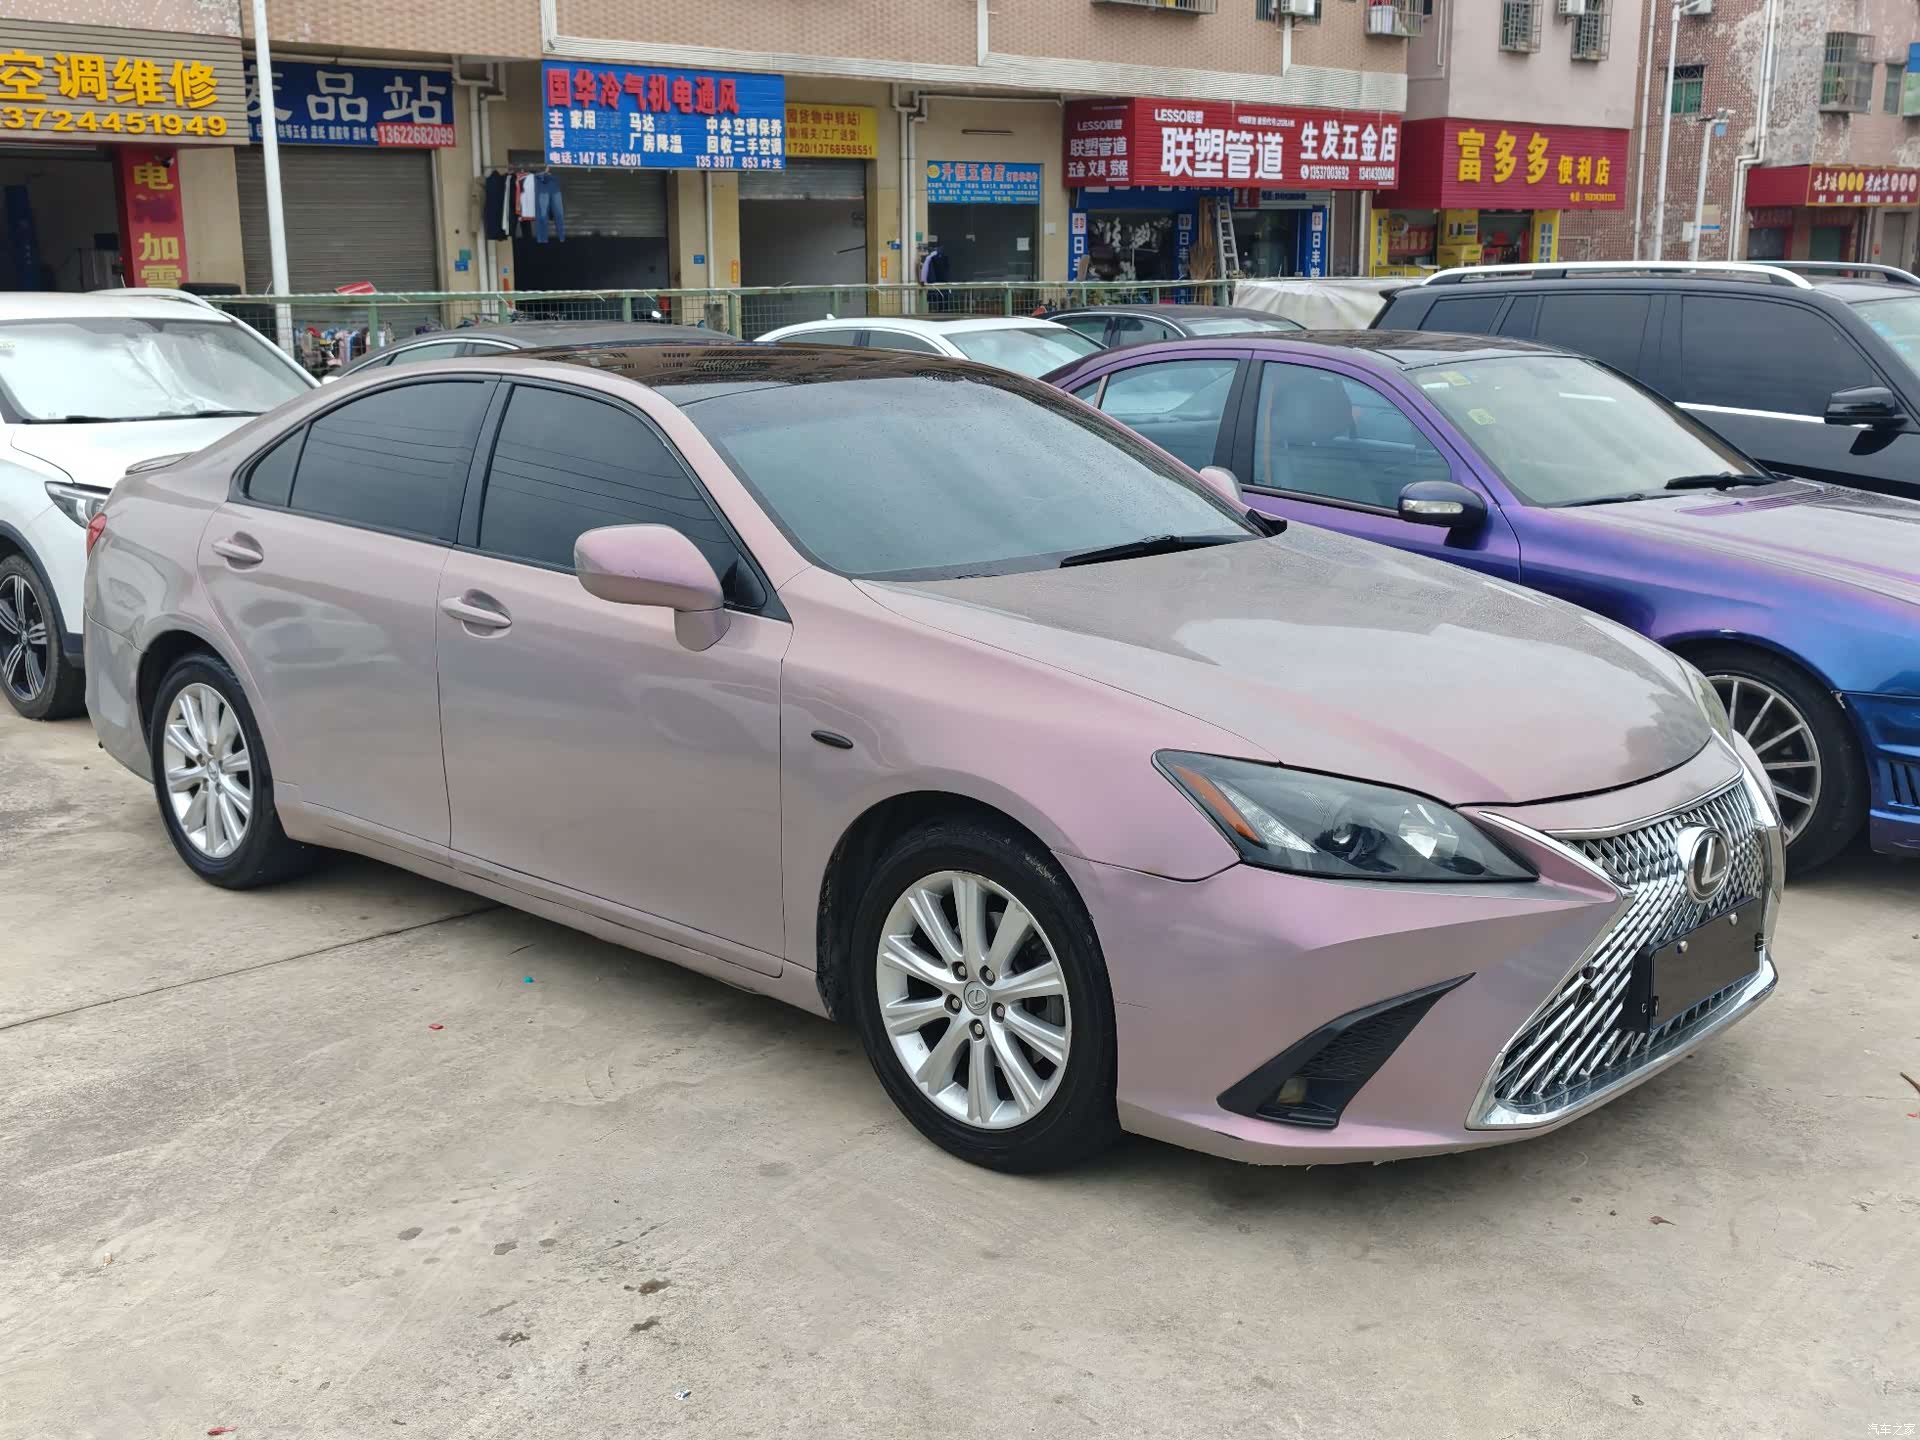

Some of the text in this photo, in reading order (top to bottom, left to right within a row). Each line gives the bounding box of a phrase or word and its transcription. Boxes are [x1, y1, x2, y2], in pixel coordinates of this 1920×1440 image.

[0, 49, 219, 109] 空调维修
[547, 68, 739, 114] 国华冷气机电通风
[2, 106, 228, 136] 3724451949
[379, 126, 454, 146] 13622682099
[706, 116, 783, 137] 中央空调保养
[629, 132, 683, 153] 厂房降温
[706, 135, 783, 155] 回收二手空调
[1070, 136, 1128, 156] 联塑管道
[1160, 127, 1284, 179] 联塑管道
[1300, 119, 1397, 162] 生发五金店
